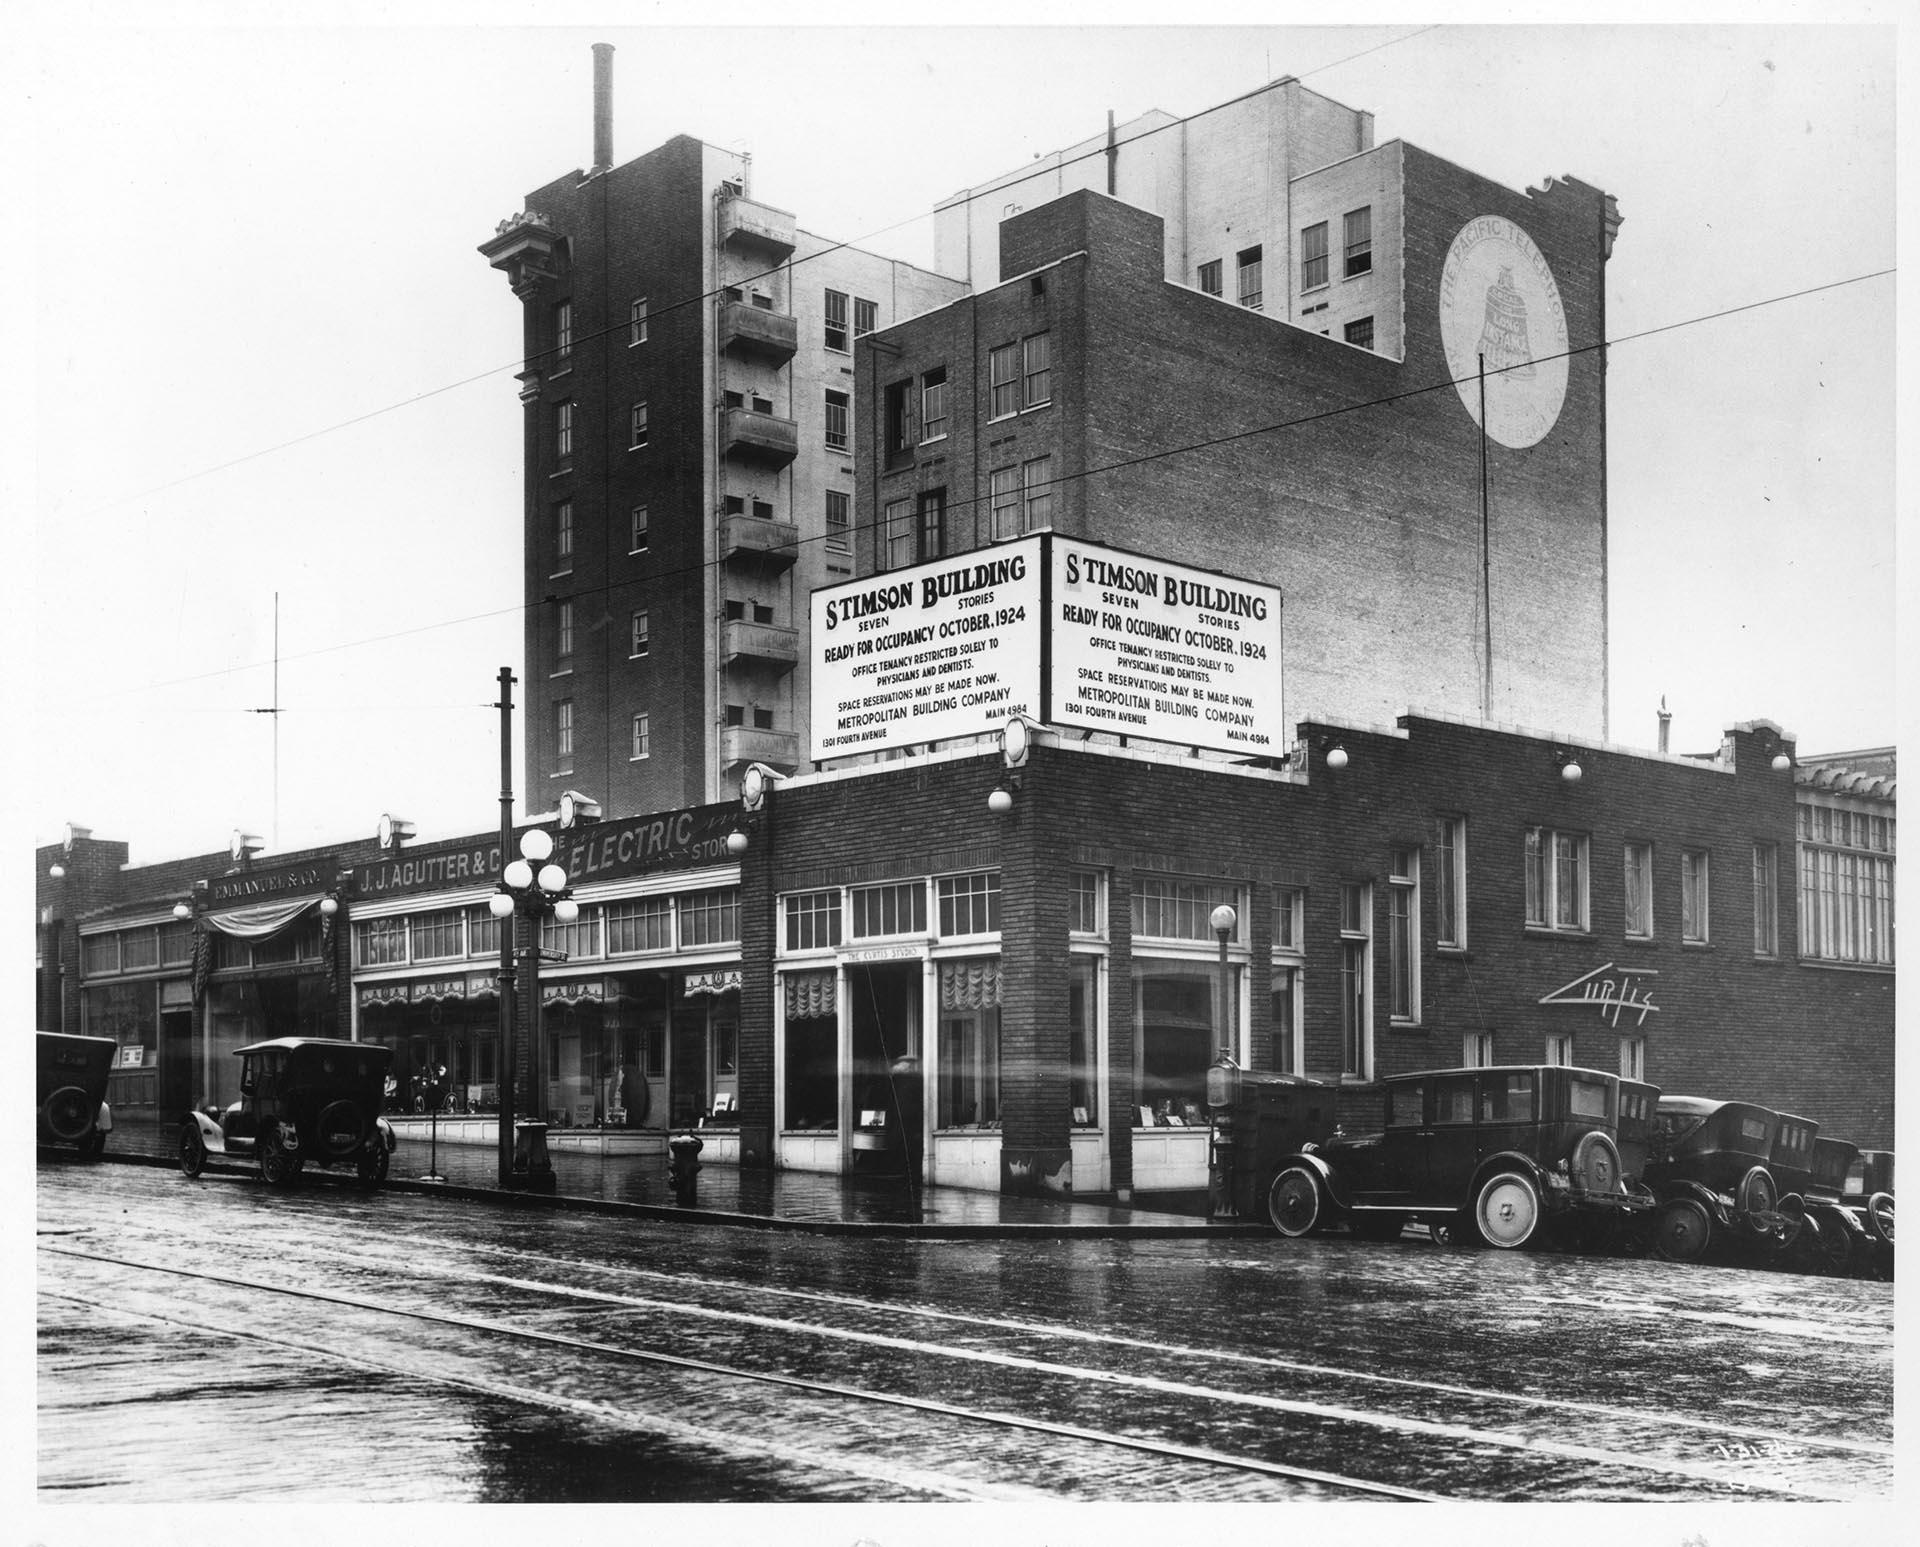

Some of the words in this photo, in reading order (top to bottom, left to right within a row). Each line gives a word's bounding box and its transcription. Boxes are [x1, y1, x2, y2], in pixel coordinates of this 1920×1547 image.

[1443, 263, 1455, 309] THE
[1453, 220, 1501, 262] PACIFIC
[1508, 224, 1566, 349] TELEPHONE
[826, 582, 913, 630] STIMSON
[921, 556, 1026, 609] BUILDING
[1067, 554, 1158, 597] STIMSON
[1164, 576, 1267, 621] BUILDING
[858, 616, 889, 632] SEVEN
[958, 592, 994, 609] STORIES
[1063, 604, 1098, 627] READY
[1103, 613, 1122, 631] FOR
[1126, 618, 1181, 644] OCCUPANCY
[1102, 592, 1139, 609] SEVEN
[1198, 613, 1240, 631] STORIES
[825, 642, 856, 663] READY
[857, 638, 873, 656] FOR
[876, 626, 935, 652] OCCUPANCY
[852, 660, 877, 677] OFFICE
[879, 654, 913, 671] TENANCY
[914, 646, 957, 664] RESTRICTED
[960, 640, 986, 655] SOLELY
[989, 638, 998, 649] TO
[1090, 637, 1116, 651] OFFICE
[1119, 642, 1152, 658] TENANCY
[1155, 650, 1195, 666] RESTRICTED
[1197, 657, 1221, 671] SOLELY
[1224, 663, 1234, 673] TO
[877, 667, 919, 686] PHYSICIANS
[922, 665, 936, 677] AND
[939, 659, 974, 675] DENTISTS.
[1078, 668, 1103, 682] SPACE
[1108, 673, 1167, 693] RESERVATIONS
[1171, 685, 1189, 696] MAY
[1193, 689, 1203, 699] BE
[1207, 692, 1229, 704] MADE
[1232, 696, 1254, 709] NOW.
[1118, 658, 1159, 674] PHYSICIANS
[1161, 666, 1175, 677] AND
[1177, 669, 1212, 683] DENTISTS.
[838, 696, 860, 712] SPACE
[863, 689, 913, 708] RESERVATIONS
[915, 686, 932, 697] MAY
[935, 684, 944, 693] BE
[948, 678, 971, 691] MADE
[976, 673, 999, 686] NOW.
[838, 707, 907, 730] METROPOLITAN
[913, 696, 957, 716] BUILDING
[961, 688, 1011, 707] COMPANY
[986, 706, 1005, 719] MAIN
[1007, 704, 1026, 716] 4984
[1078, 686, 1150, 710] METROPOLITAN
[1155, 701, 1198, 718] BUILDING
[1205, 708, 1254, 727] COMPANY
[1065, 703, 1082, 713] 1301
[1086, 706, 1116, 719] FOURTH
[1118, 712, 1147, 724] AVENUE
[823, 737, 836, 747] 1301
[837, 734, 860, 745] FOURTH
[861, 729, 887, 742] AVENUE
[1227, 730, 1247, 741] MAIN
[1250, 732, 1270, 744] 4984
[552, 835, 565, 851] HE
[568, 812, 694, 879] ELECTRIC
[288, 872, 298, 888] &
[391, 853, 469, 887] AGUTTER
[473, 850, 485, 875] &
[848, 952, 859, 961] THE
